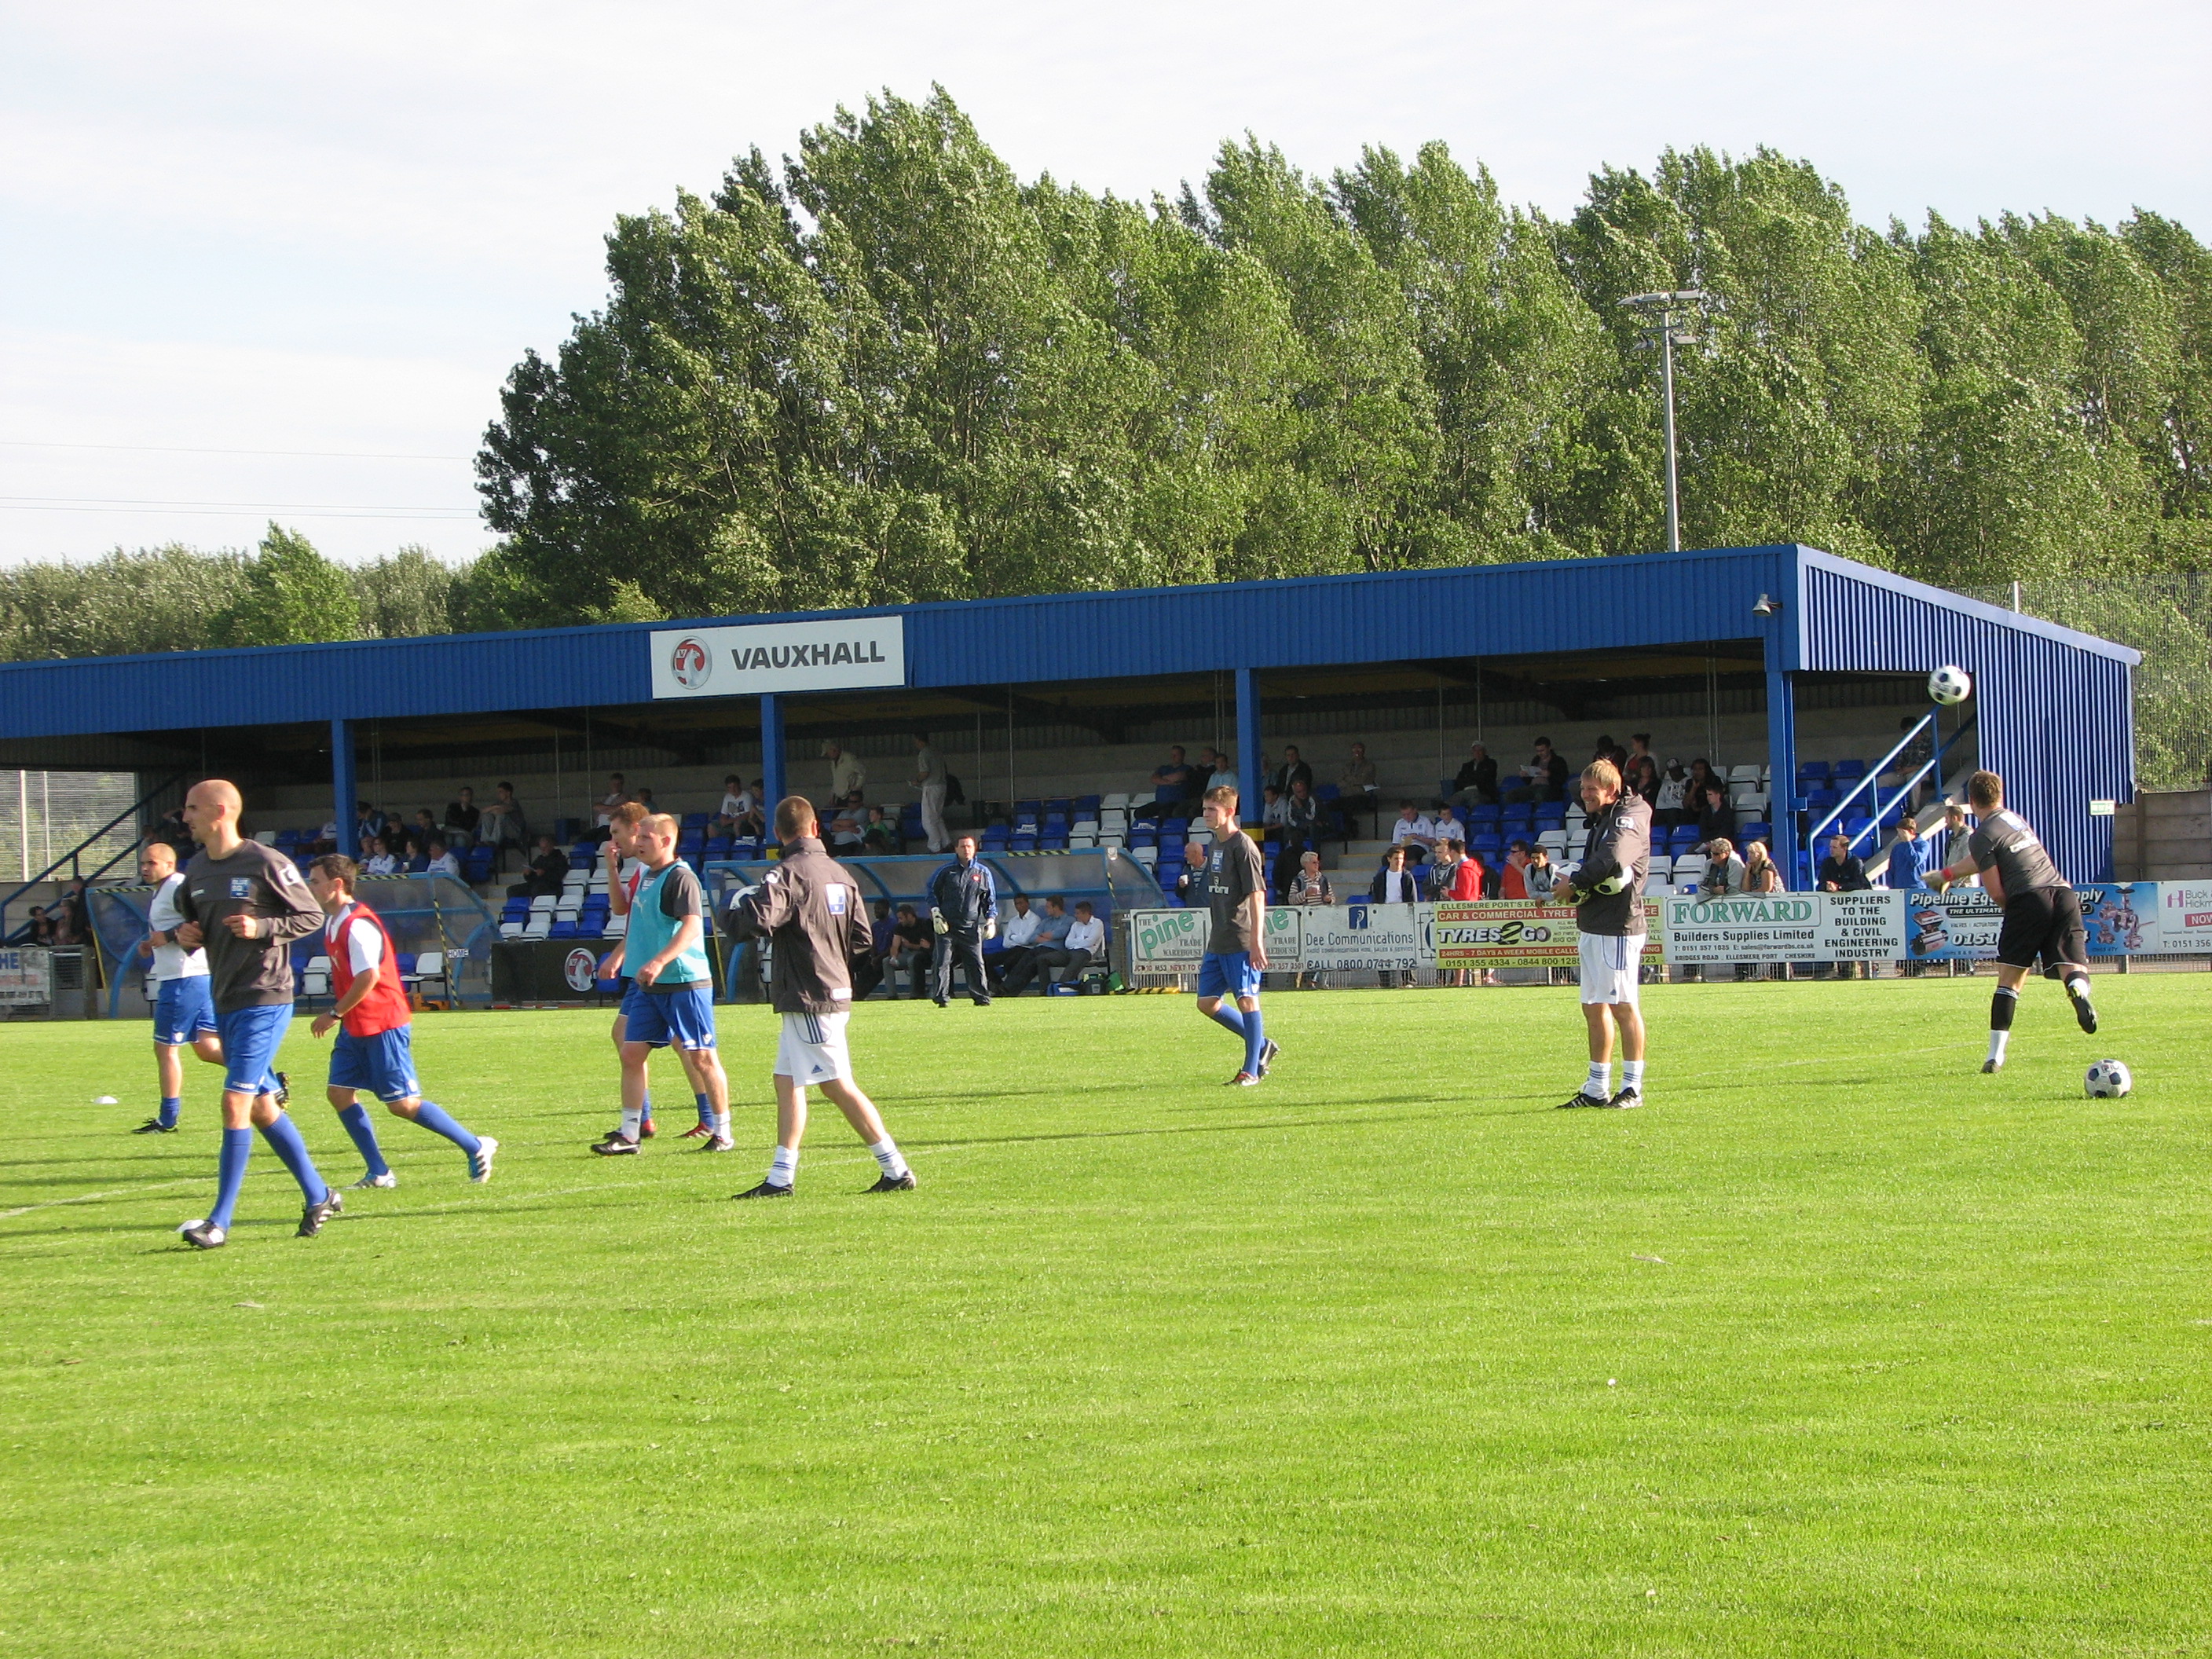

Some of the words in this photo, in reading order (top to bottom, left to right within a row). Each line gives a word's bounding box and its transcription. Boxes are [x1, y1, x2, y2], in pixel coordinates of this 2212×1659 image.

[731, 641, 885, 670] VAUXHALL
[1830, 895, 1891, 905] SUPPLIERS
[1910, 892, 1969, 908] Pipeline
[2185, 890, 2207, 899] Buck
[1438, 912, 1460, 921] CAR
[1471, 910, 1540, 920] COMMERCIAL
[1672, 901, 1812, 924] FORWARD
[1859, 906, 1881, 915] THE
[1835, 917, 1886, 926] BUILDING
[1140, 911, 1195, 959] pine
[1674, 932, 1719, 942] Builders
[1723, 930, 1769, 943] Supplies
[1773, 929, 1815, 939] Limited
[1853, 928, 1882, 936] CIVIL
[1306, 933, 1324, 946] Dee
[1328, 931, 1413, 946] Communications
[1825, 938, 1899, 947] ENGINEERING
[1952, 932, 1998, 946] 0151
[446, 949, 469, 958] HOME
[1835, 949, 1889, 958] INDUSTRY
[1307, 960, 1334, 970] CALL
[1337, 959, 1363, 969] 0800
[1367, 959, 1392, 969] 0744
[1395, 958, 1415, 969] 792
